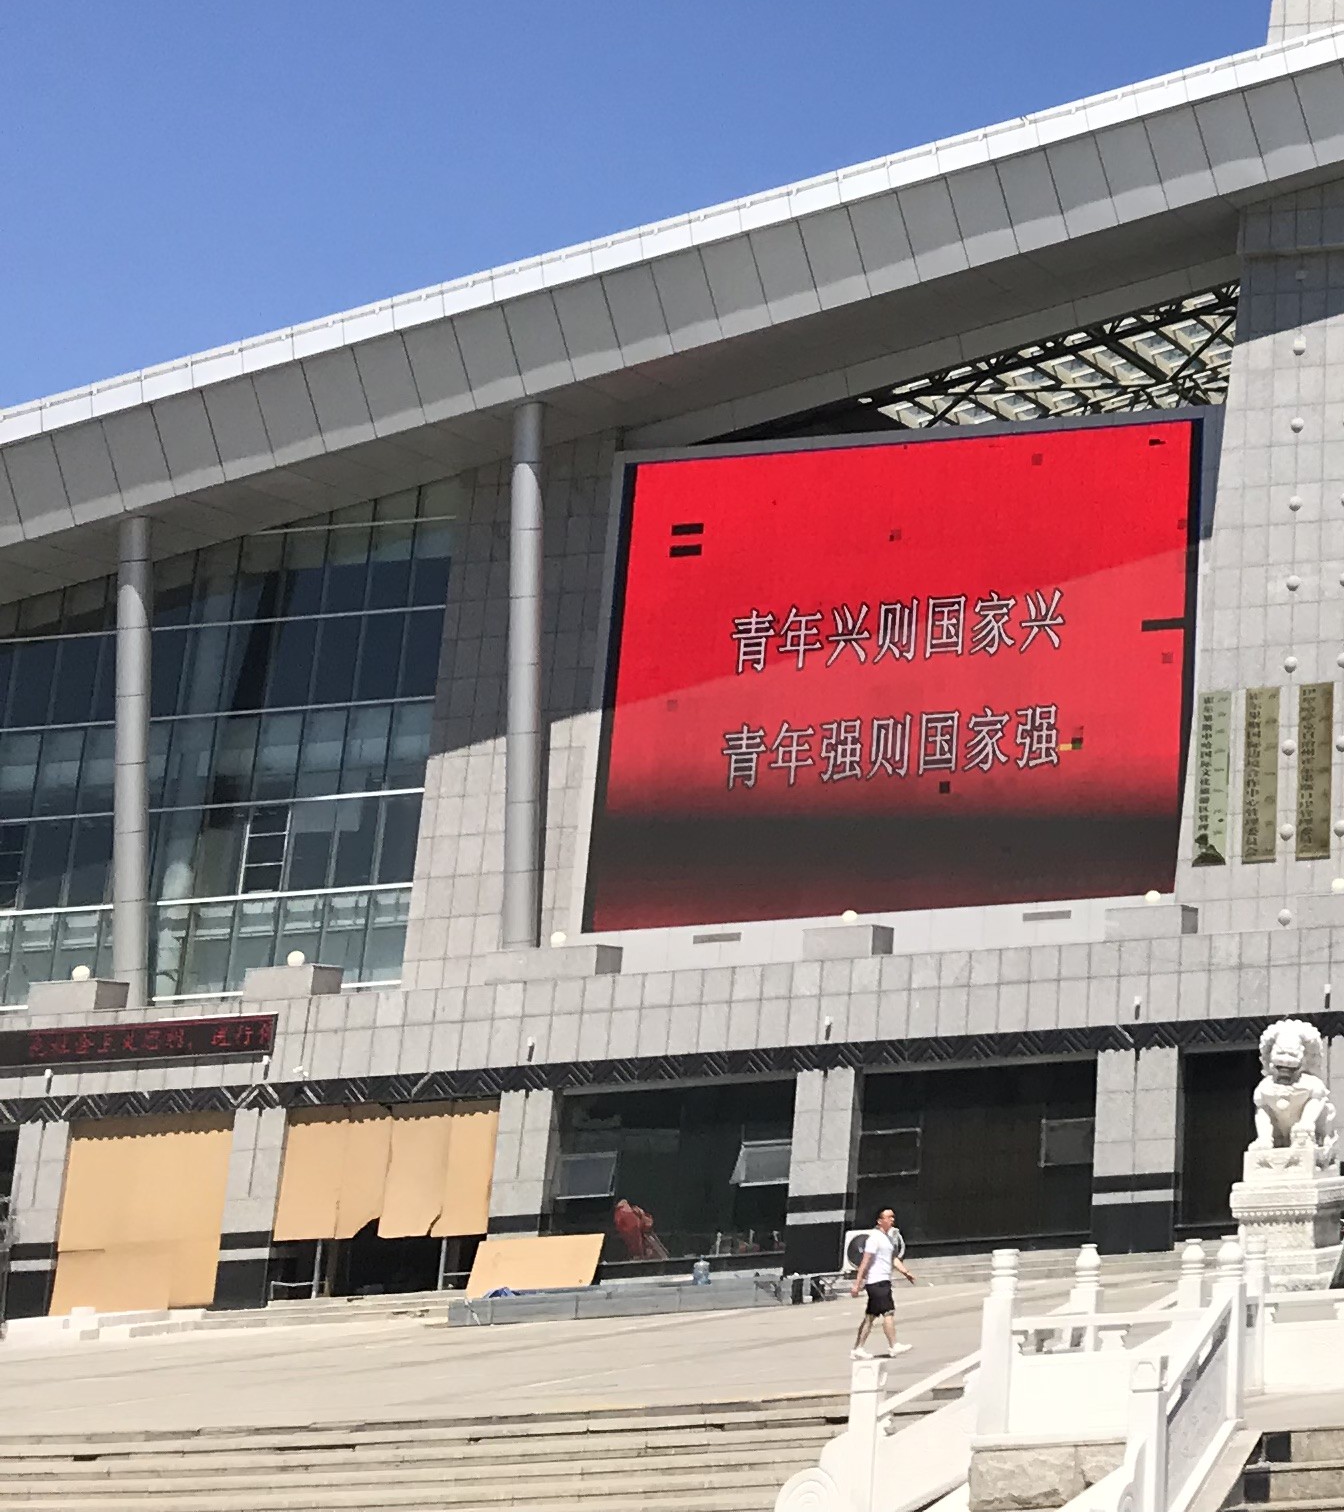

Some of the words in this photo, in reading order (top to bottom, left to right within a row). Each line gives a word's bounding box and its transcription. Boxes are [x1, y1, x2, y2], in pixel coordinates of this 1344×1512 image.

[732, 589, 1065, 675] 青年兴则国家兴
[723, 704, 1059, 790] 青年强则国家强
